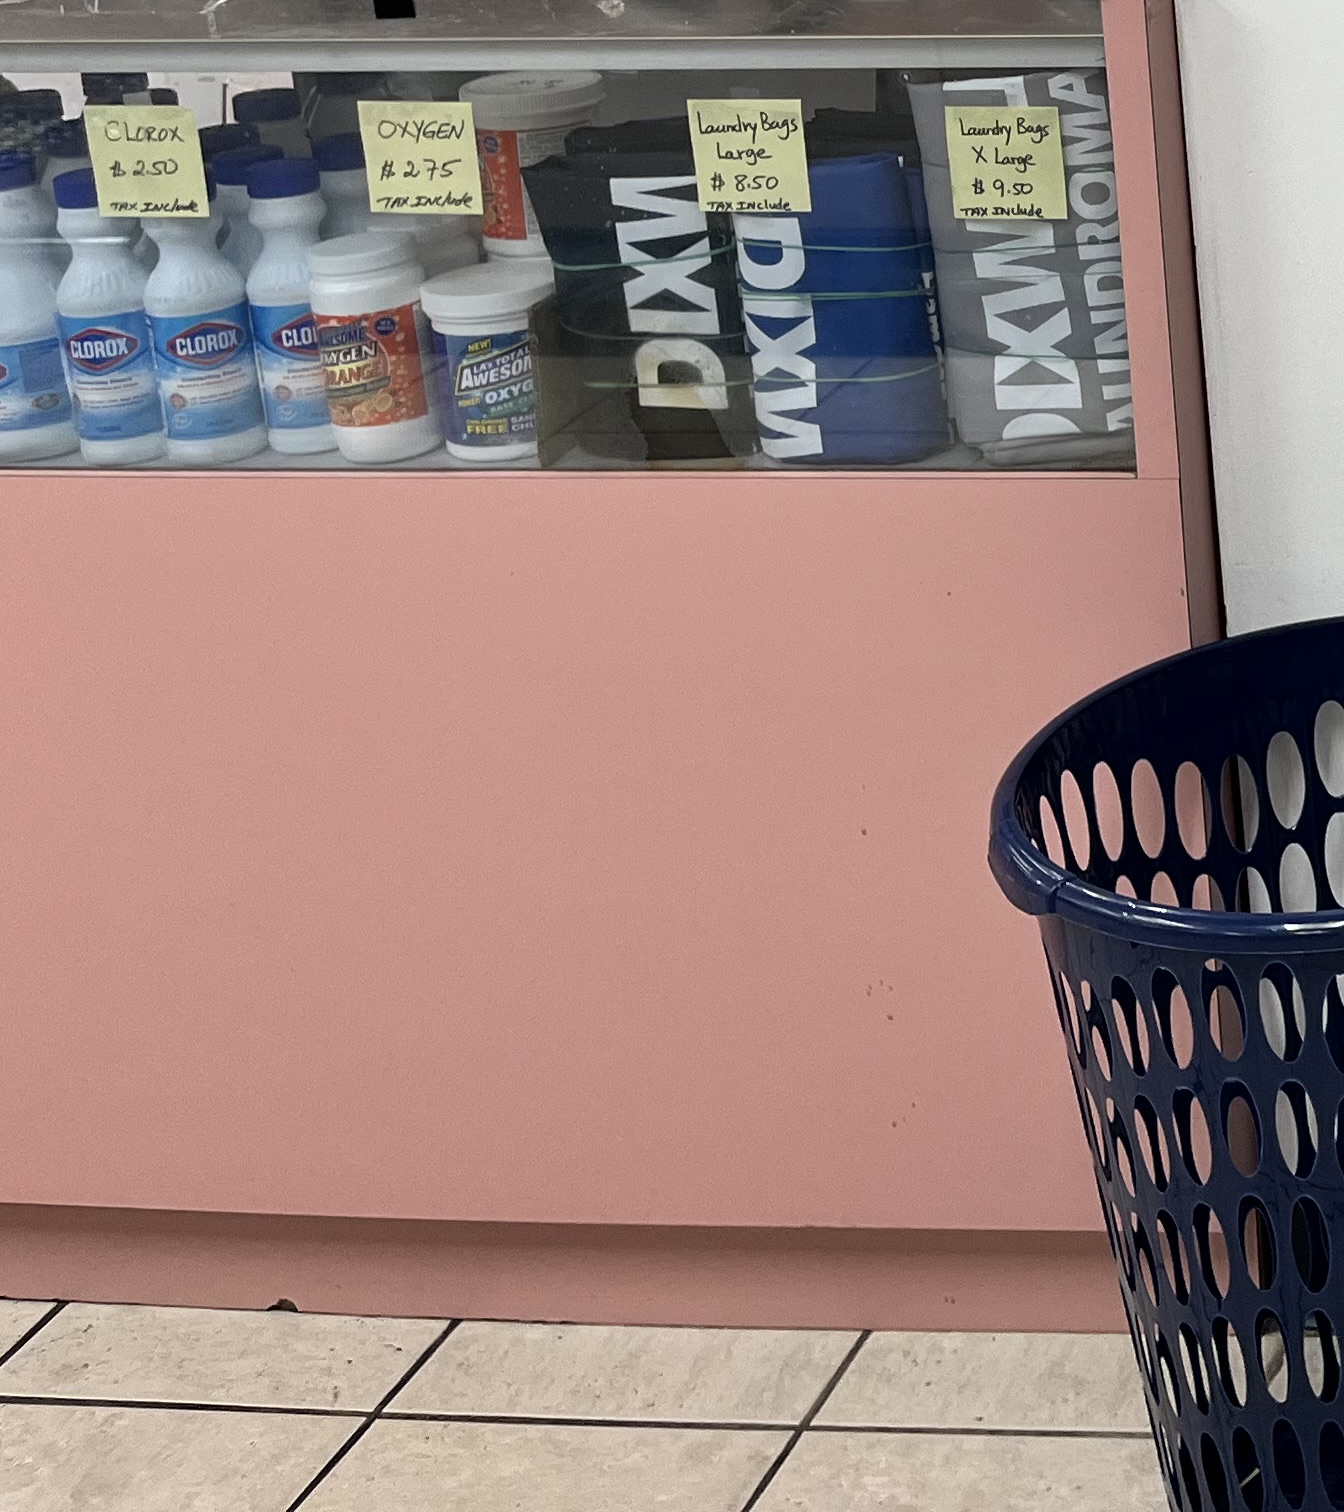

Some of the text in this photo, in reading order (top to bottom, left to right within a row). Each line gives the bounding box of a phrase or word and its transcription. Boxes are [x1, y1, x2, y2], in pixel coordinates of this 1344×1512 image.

[104, 120, 185, 143] CLOROX
[378, 120, 465, 144] OXYGEN
[696, 110, 799, 144] Laundry Bags
[959, 117, 1050, 146] Laundry Bags
[716, 141, 773, 166] Large
[971, 145, 1036, 173] X Large
[710, 172, 779, 192] $ 8.50
[992, 179, 1034, 198] 9.50
[376, 196, 410, 209] TAX
[706, 201, 734, 210] TAX
[960, 207, 988, 217] TAX
[70, 337, 129, 359] CLOROX
[175, 328, 238, 356] CLOROX
[281, 327, 318, 348] CLO
